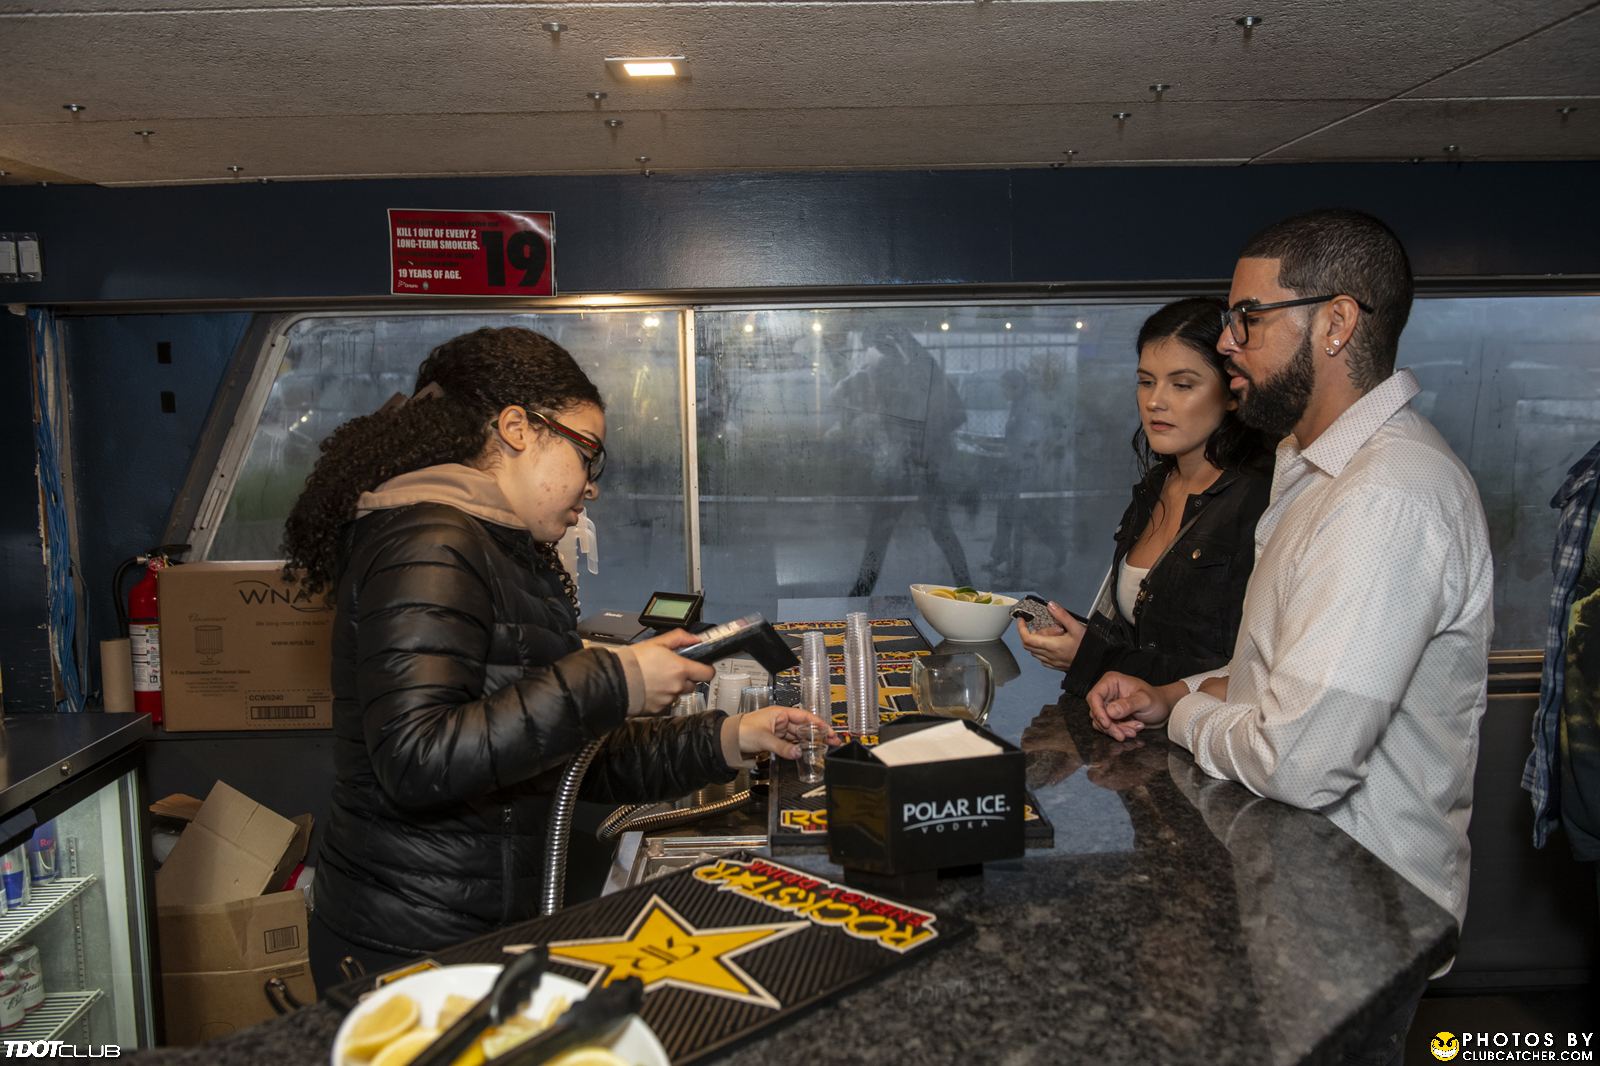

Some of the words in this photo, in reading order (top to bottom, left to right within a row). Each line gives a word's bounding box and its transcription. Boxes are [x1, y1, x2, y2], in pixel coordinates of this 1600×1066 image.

[396, 227, 412, 237] KILL
[418, 227, 434, 238] OUT
[434, 228, 445, 238] OF
[445, 228, 470, 239] EVERY
[471, 229, 477, 239] 2
[396, 238, 439, 249] LONG-TERM
[439, 240, 480, 251] SMOKERS.
[481, 230, 547, 287] 19
[398, 268, 408, 278] 19
[408, 268, 433, 279] YEARS
[433, 269, 444, 279] OF
[444, 269, 462, 280] AGE.
[238, 587, 313, 605] WNA
[903, 798, 971, 823] POLAR
[921, 819, 988, 835] VODKA
[743, 859, 823, 891] DRINK
[821, 886, 935, 928] ENERGY
